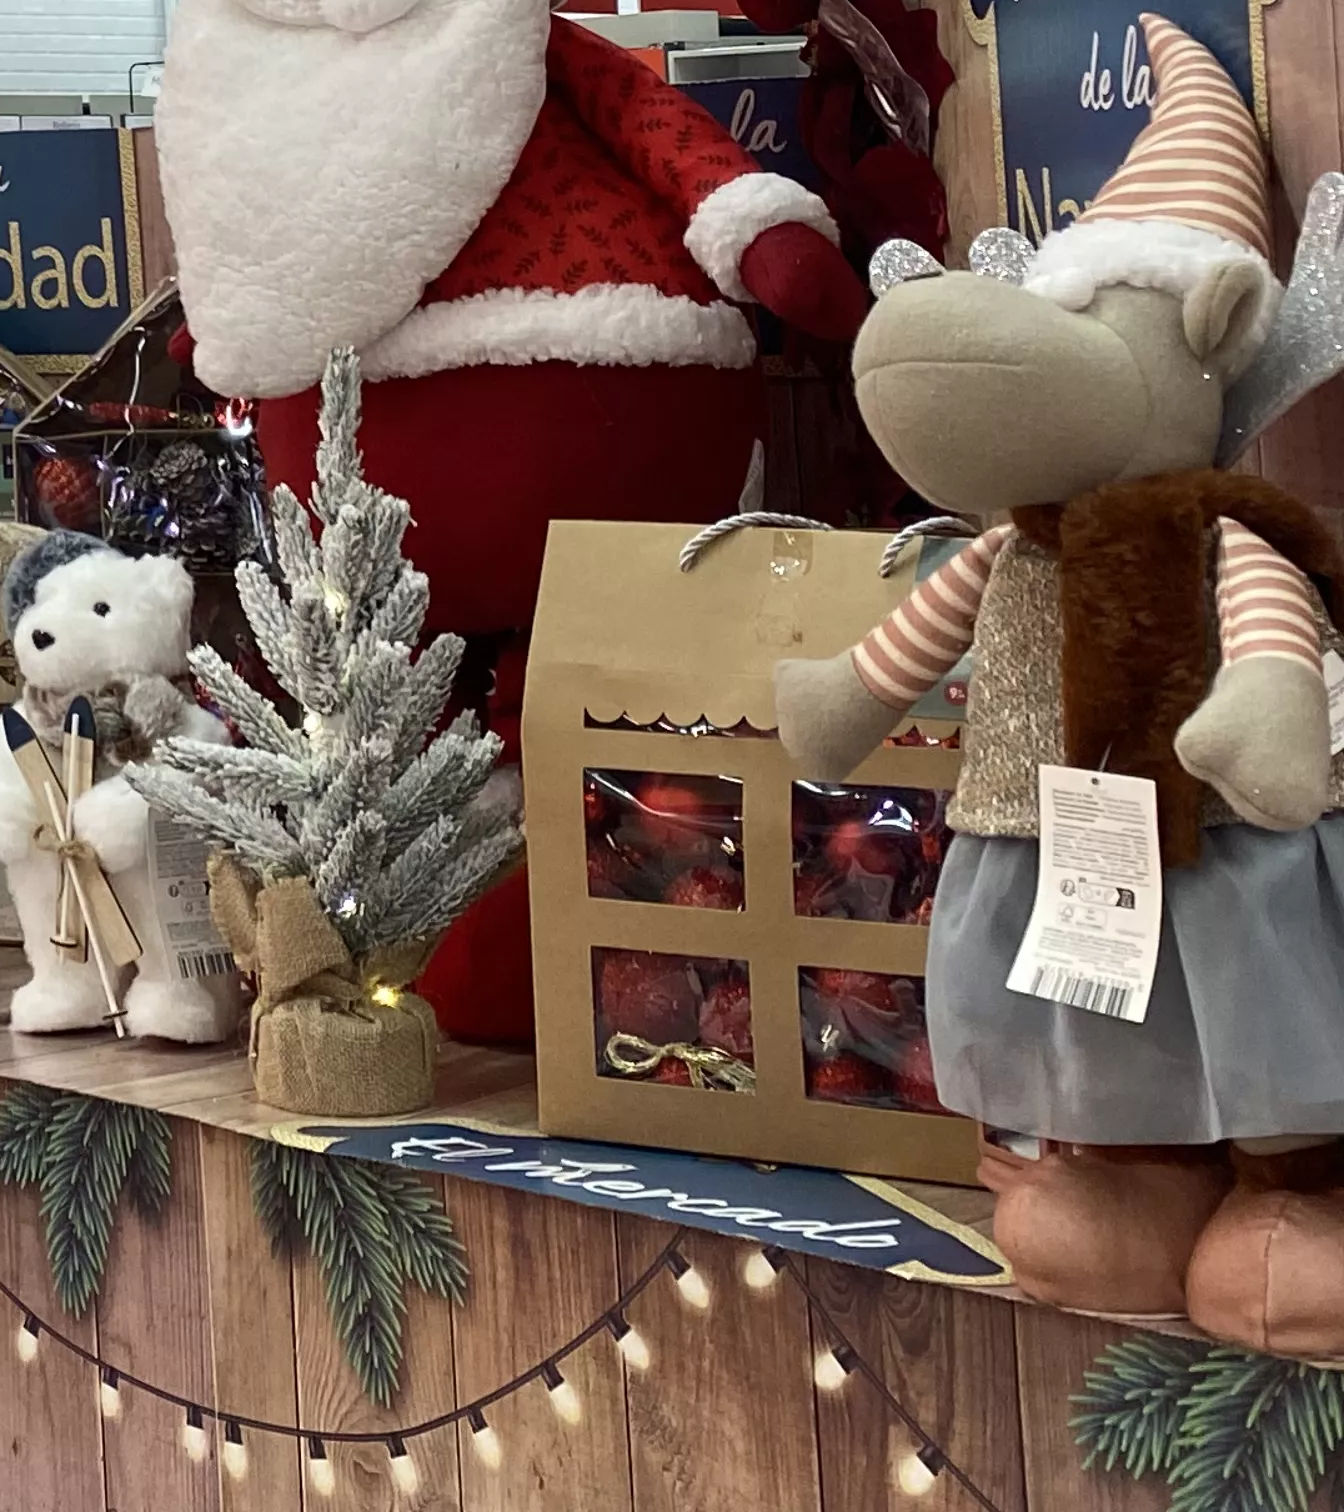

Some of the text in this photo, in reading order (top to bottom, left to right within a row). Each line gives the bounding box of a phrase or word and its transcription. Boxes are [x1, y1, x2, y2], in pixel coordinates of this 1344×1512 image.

[1080, 24, 1158, 110] de la
[730, 88, 788, 153] la
[390, 1136, 901, 1250] El mercado
